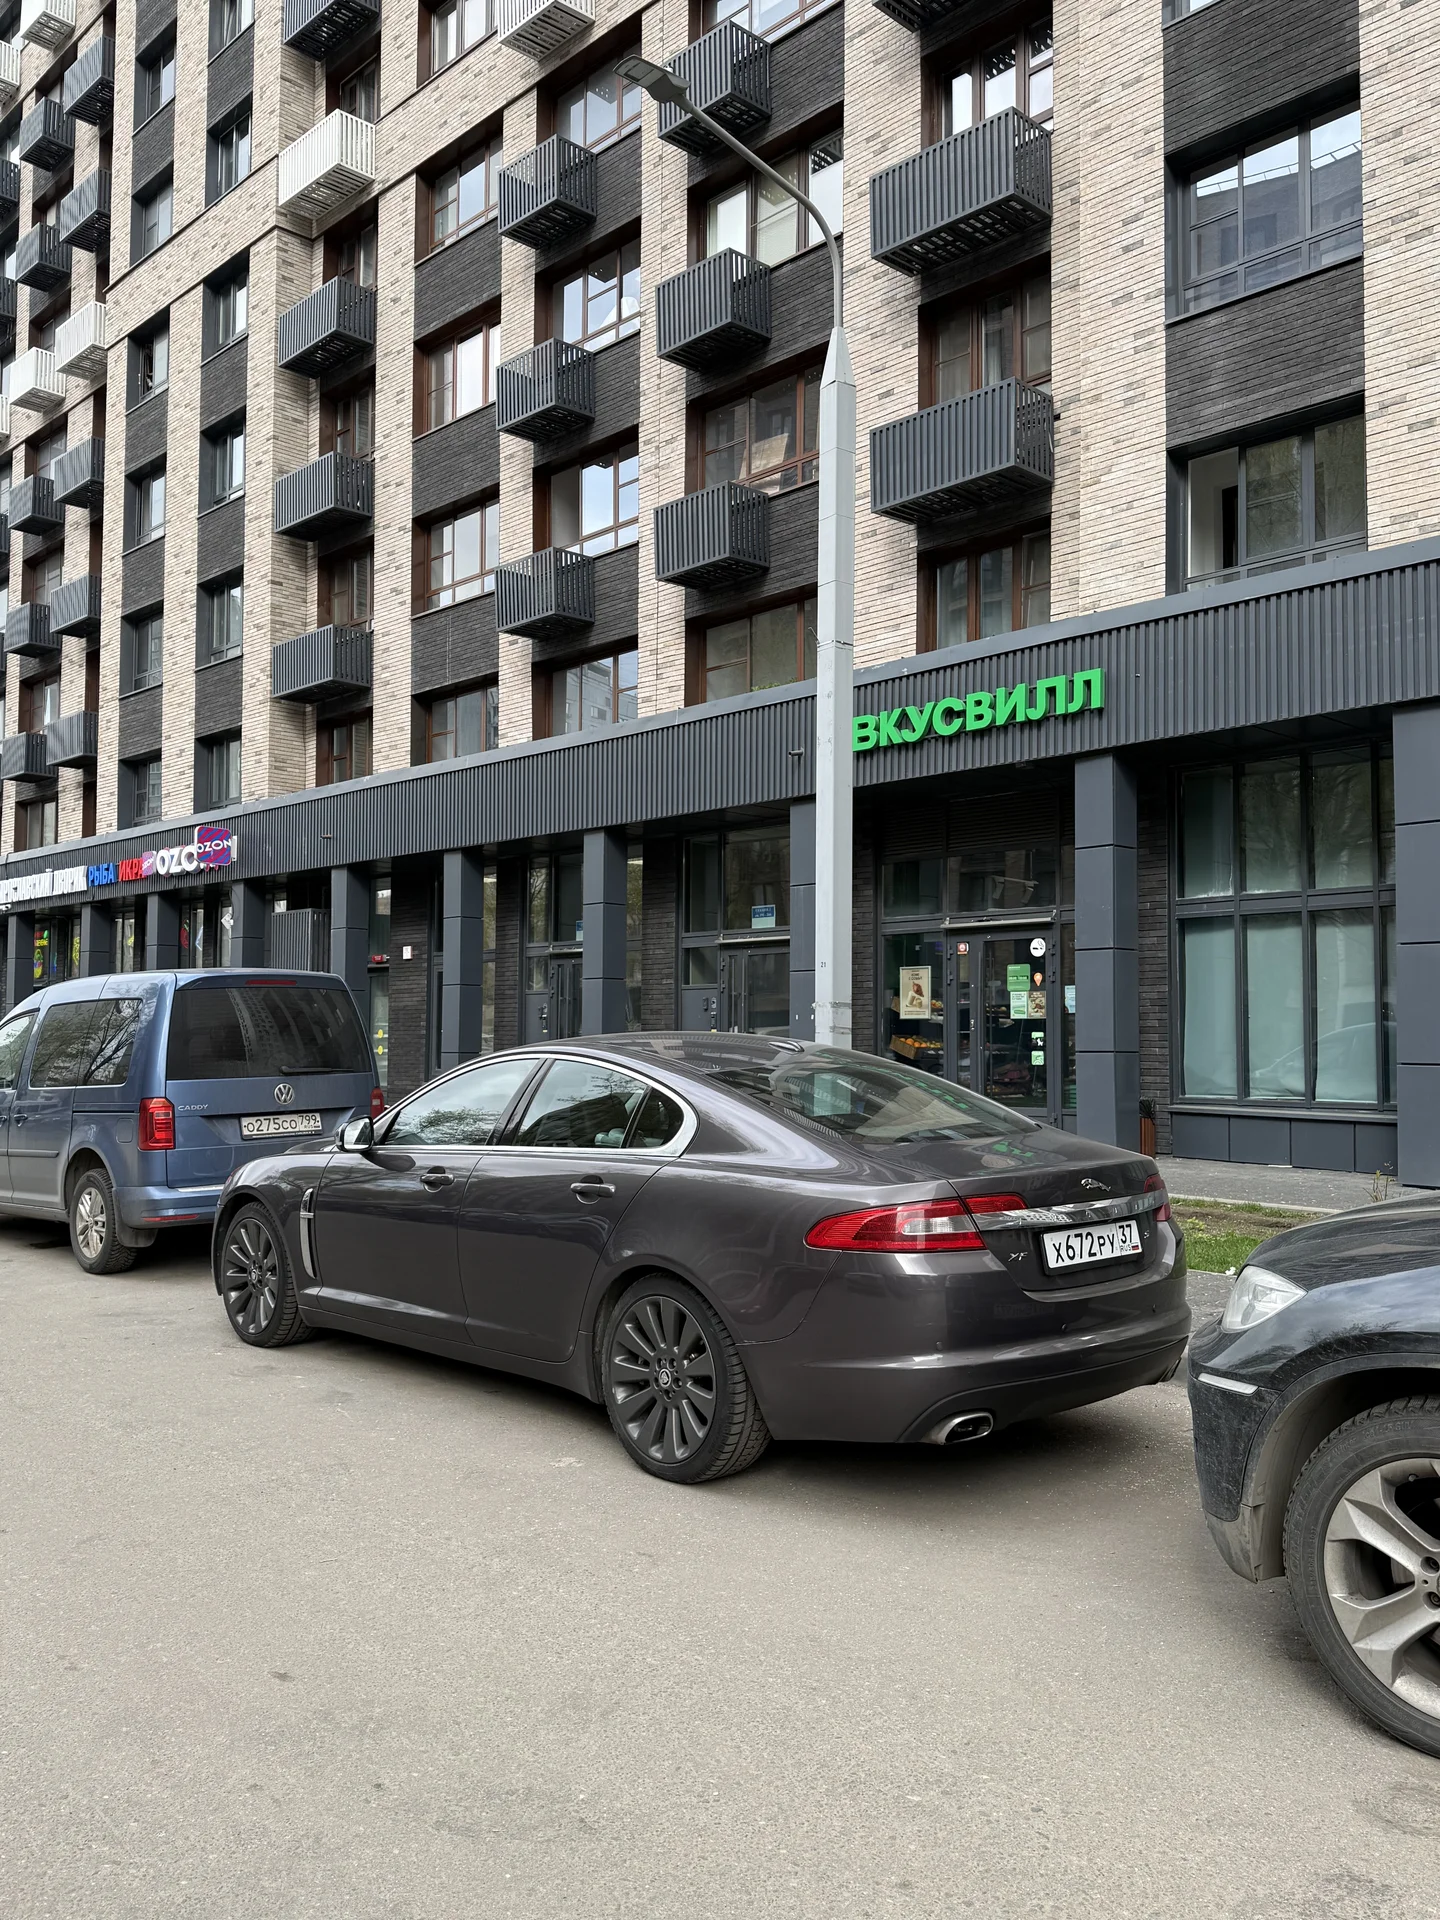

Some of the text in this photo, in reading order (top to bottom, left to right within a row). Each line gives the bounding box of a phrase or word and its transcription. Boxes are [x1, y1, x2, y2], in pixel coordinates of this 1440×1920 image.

[852, 667, 1105, 752] ВКУСВИЛЛ
[156, 836, 237, 876] OZO
[197, 839, 232, 853] OZON
[88, 862, 117, 887] РЫБА
[298, 1114, 317, 1126] 799
[1118, 1223, 1132, 1245] 37
[1120, 1243, 1131, 1252] RUS
